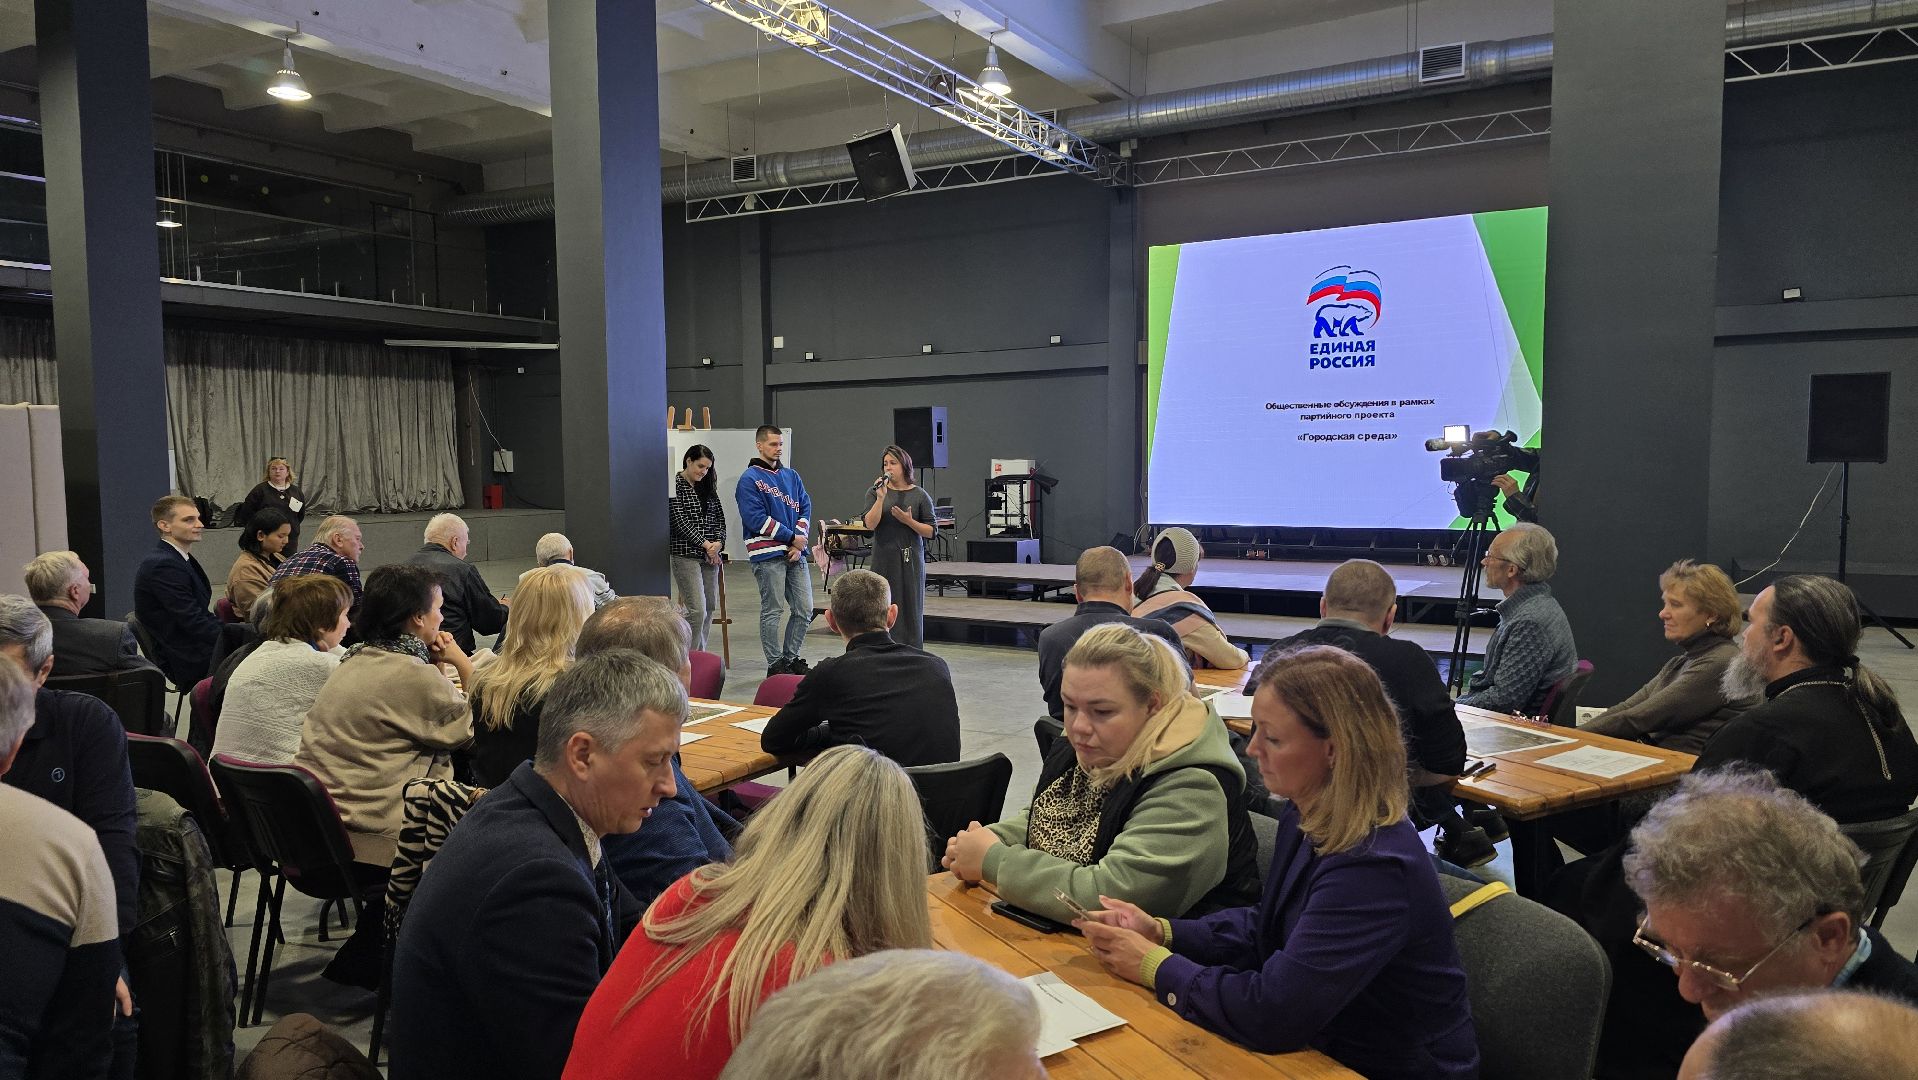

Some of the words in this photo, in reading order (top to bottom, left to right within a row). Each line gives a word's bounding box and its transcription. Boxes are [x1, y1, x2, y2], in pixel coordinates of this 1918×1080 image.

[1310, 340, 1375, 355] ЕДИНАЯ
[1310, 354, 1375, 369] РОССИЯ
[1265, 402, 1332, 411] Общественные
[1334, 400, 1389, 409] обсуждения
[1399, 398, 1435, 407] рамках
[1300, 412, 1352, 421] партийного
[1354, 411, 1395, 420] проекта
[1297, 433, 1355, 442] «Городская
[1357, 433, 1398, 441] среда»
